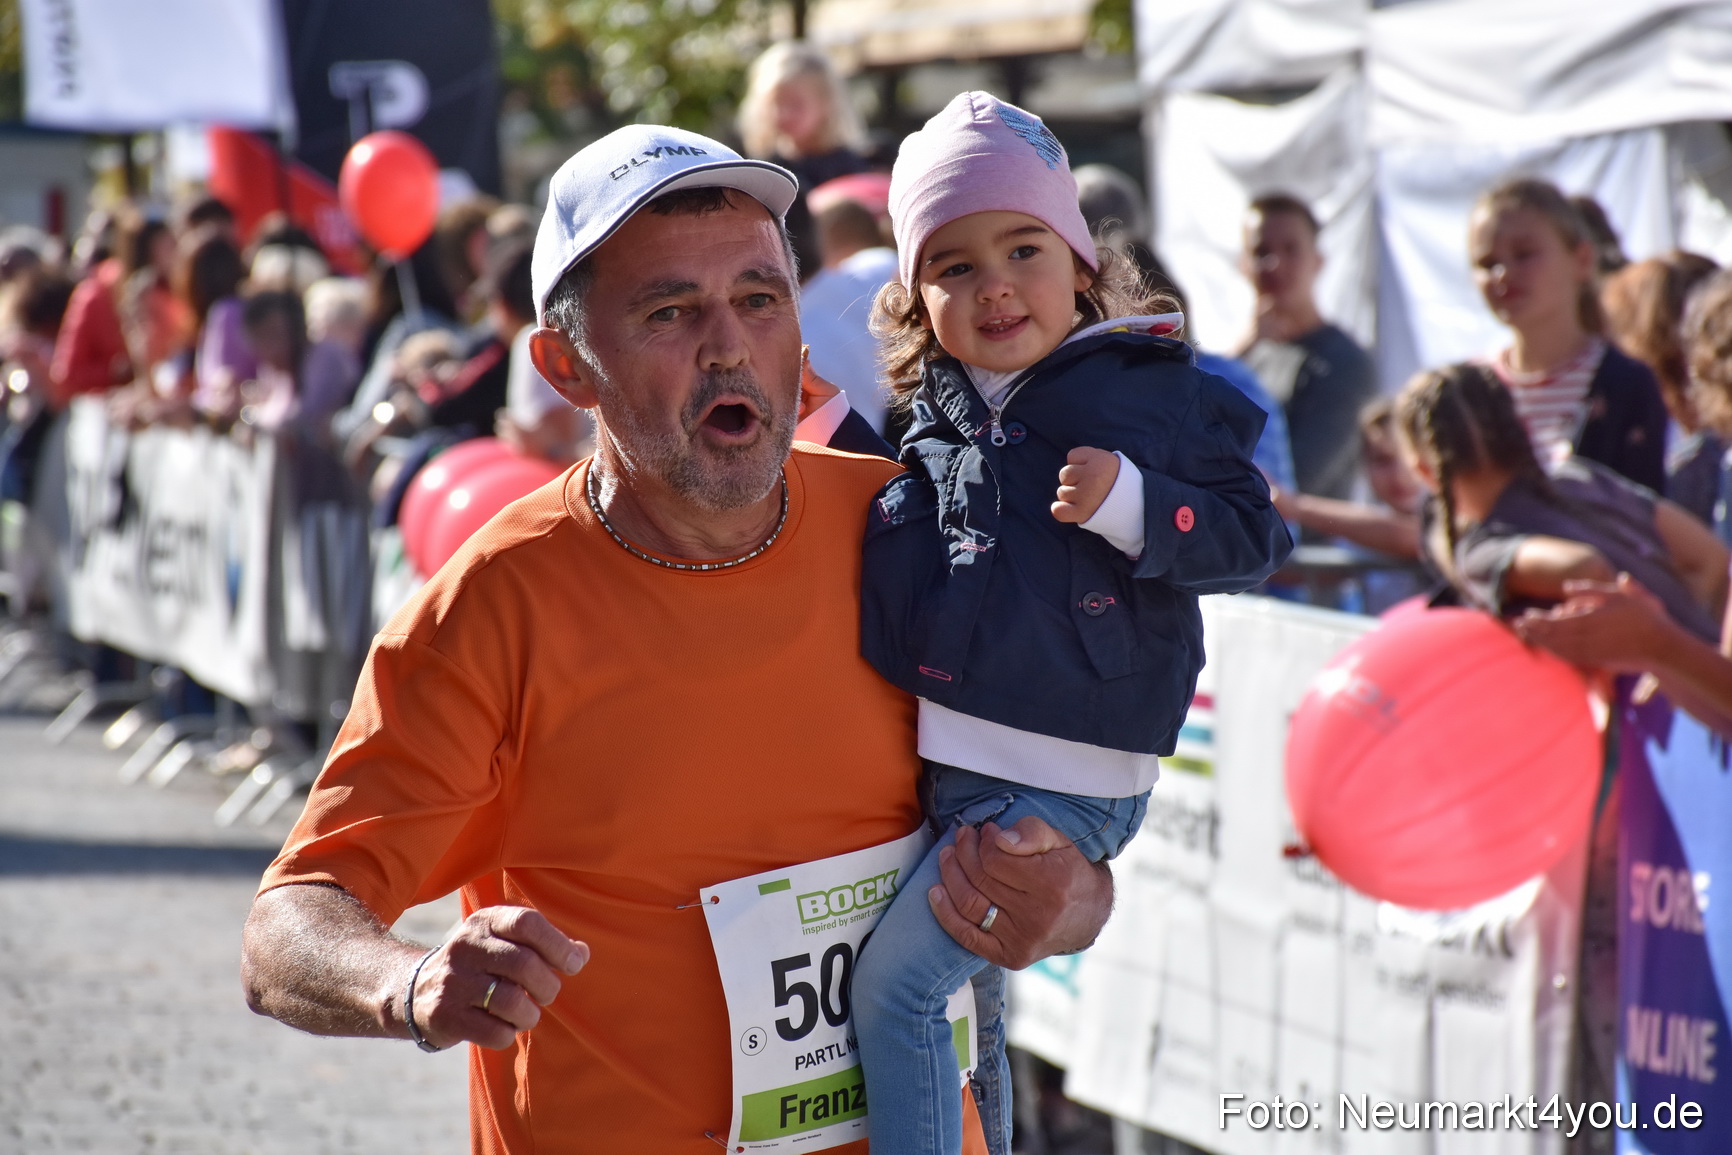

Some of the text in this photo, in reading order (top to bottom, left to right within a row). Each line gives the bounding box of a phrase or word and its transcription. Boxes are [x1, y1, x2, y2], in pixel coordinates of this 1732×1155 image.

[609, 145, 708, 181] OLYMP
[796, 868, 900, 925] BOCK
[802, 919, 837, 936] inspired
[839, 917, 849, 927] by
[850, 910, 871, 924] smart
[770, 930, 876, 1042] 50
[748, 1034, 758, 1049] S
[795, 1042, 847, 1071] PARTL
[780, 1082, 867, 1129] Franz
